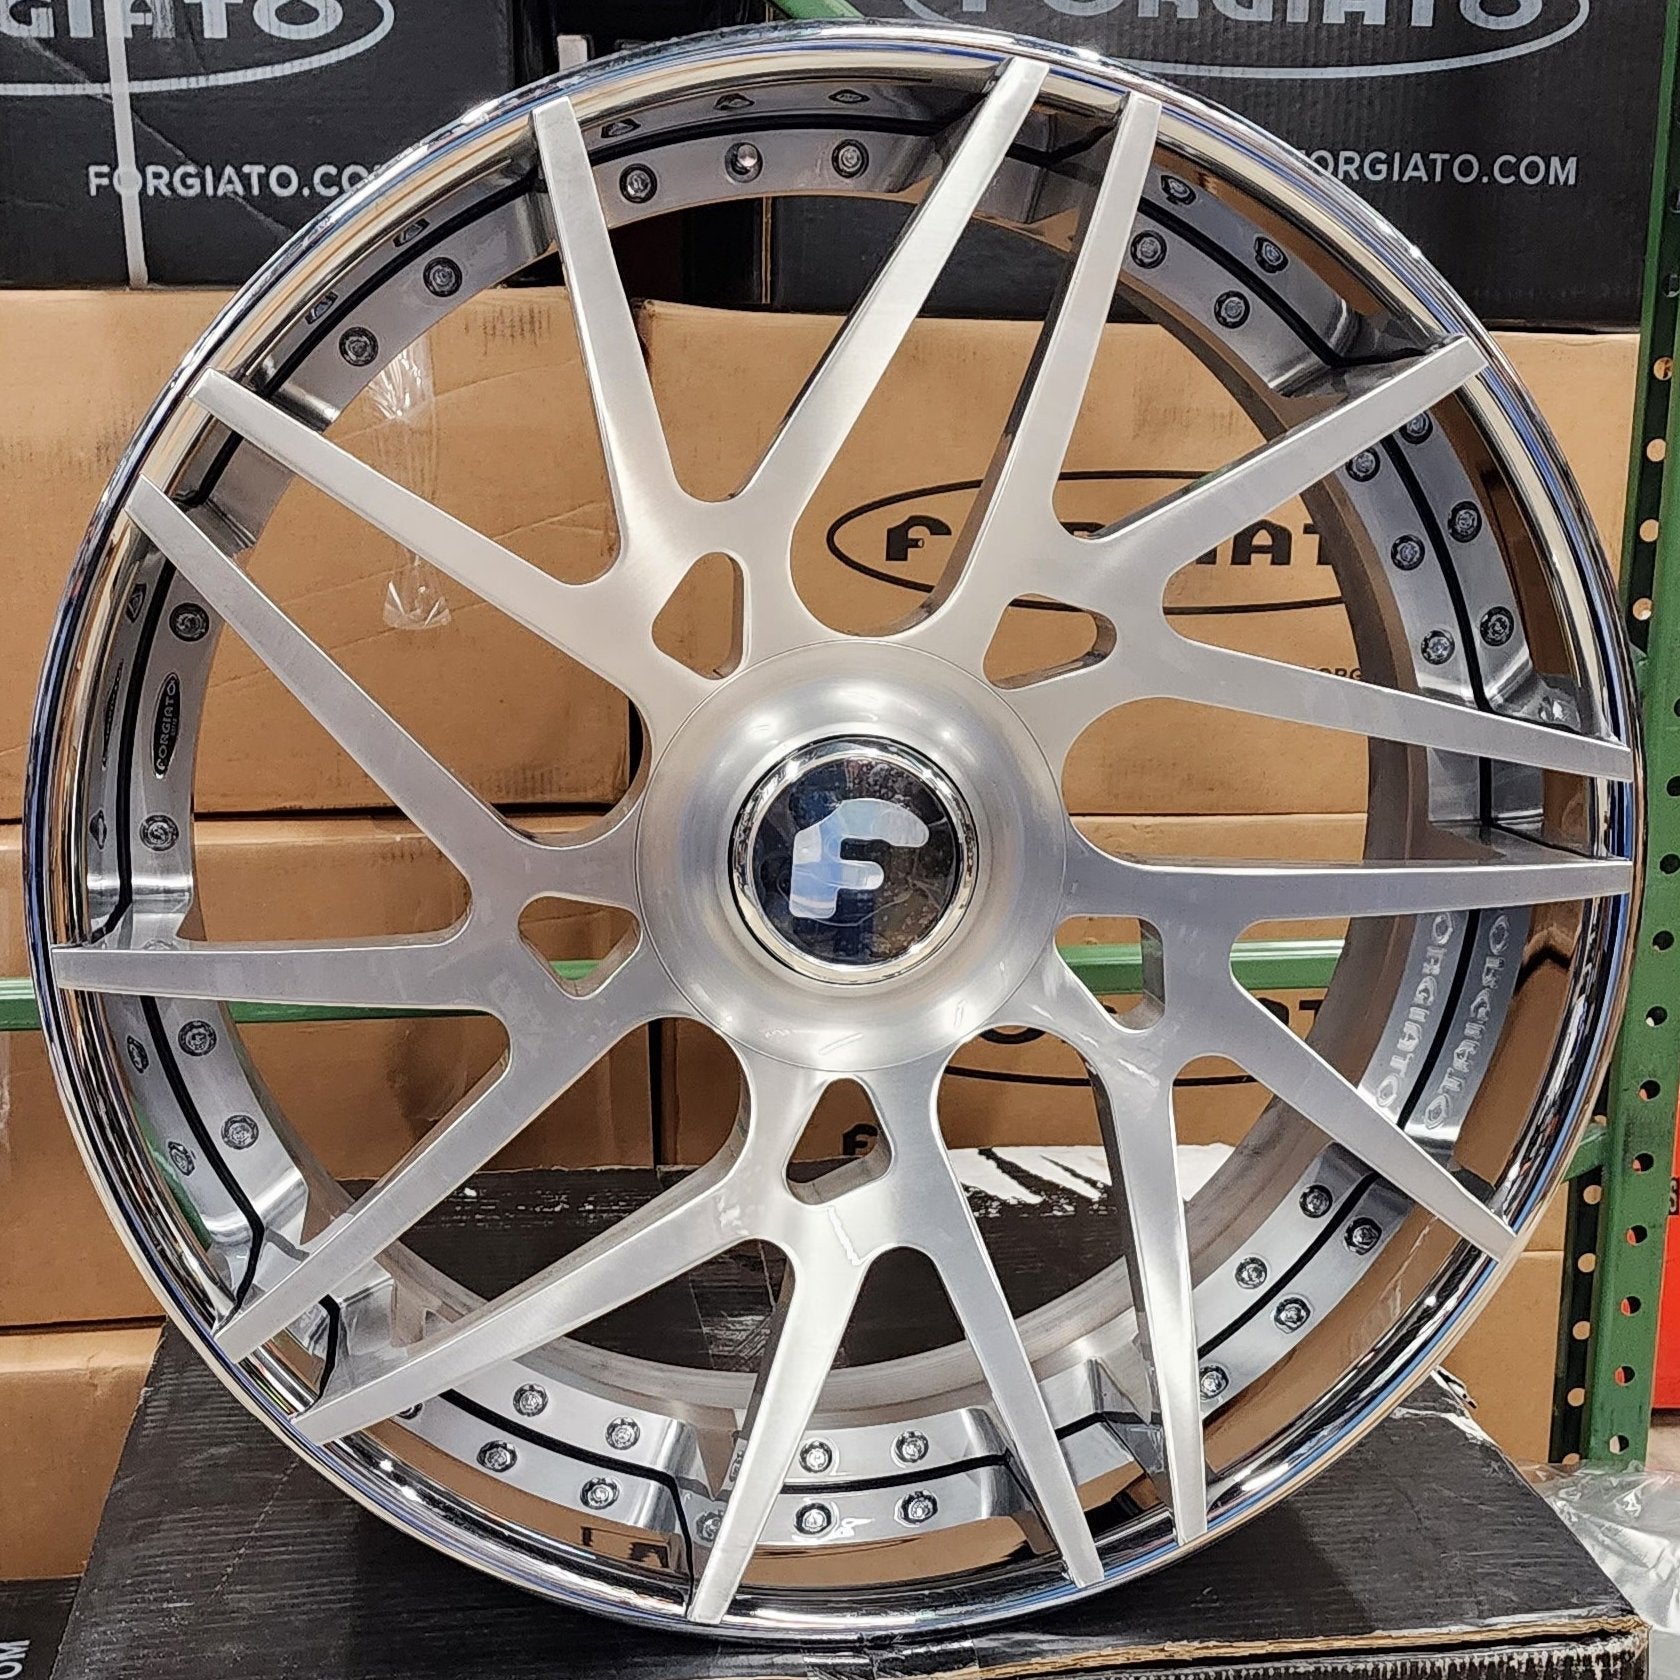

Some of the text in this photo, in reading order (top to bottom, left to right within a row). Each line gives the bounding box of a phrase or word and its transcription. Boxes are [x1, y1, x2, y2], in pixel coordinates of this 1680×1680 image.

[87, 163, 381, 198] FORGIATO.CO
[1300, 149, 1577, 186] ORGIATO.COM
[155, 679, 177, 771] FORGIATO
